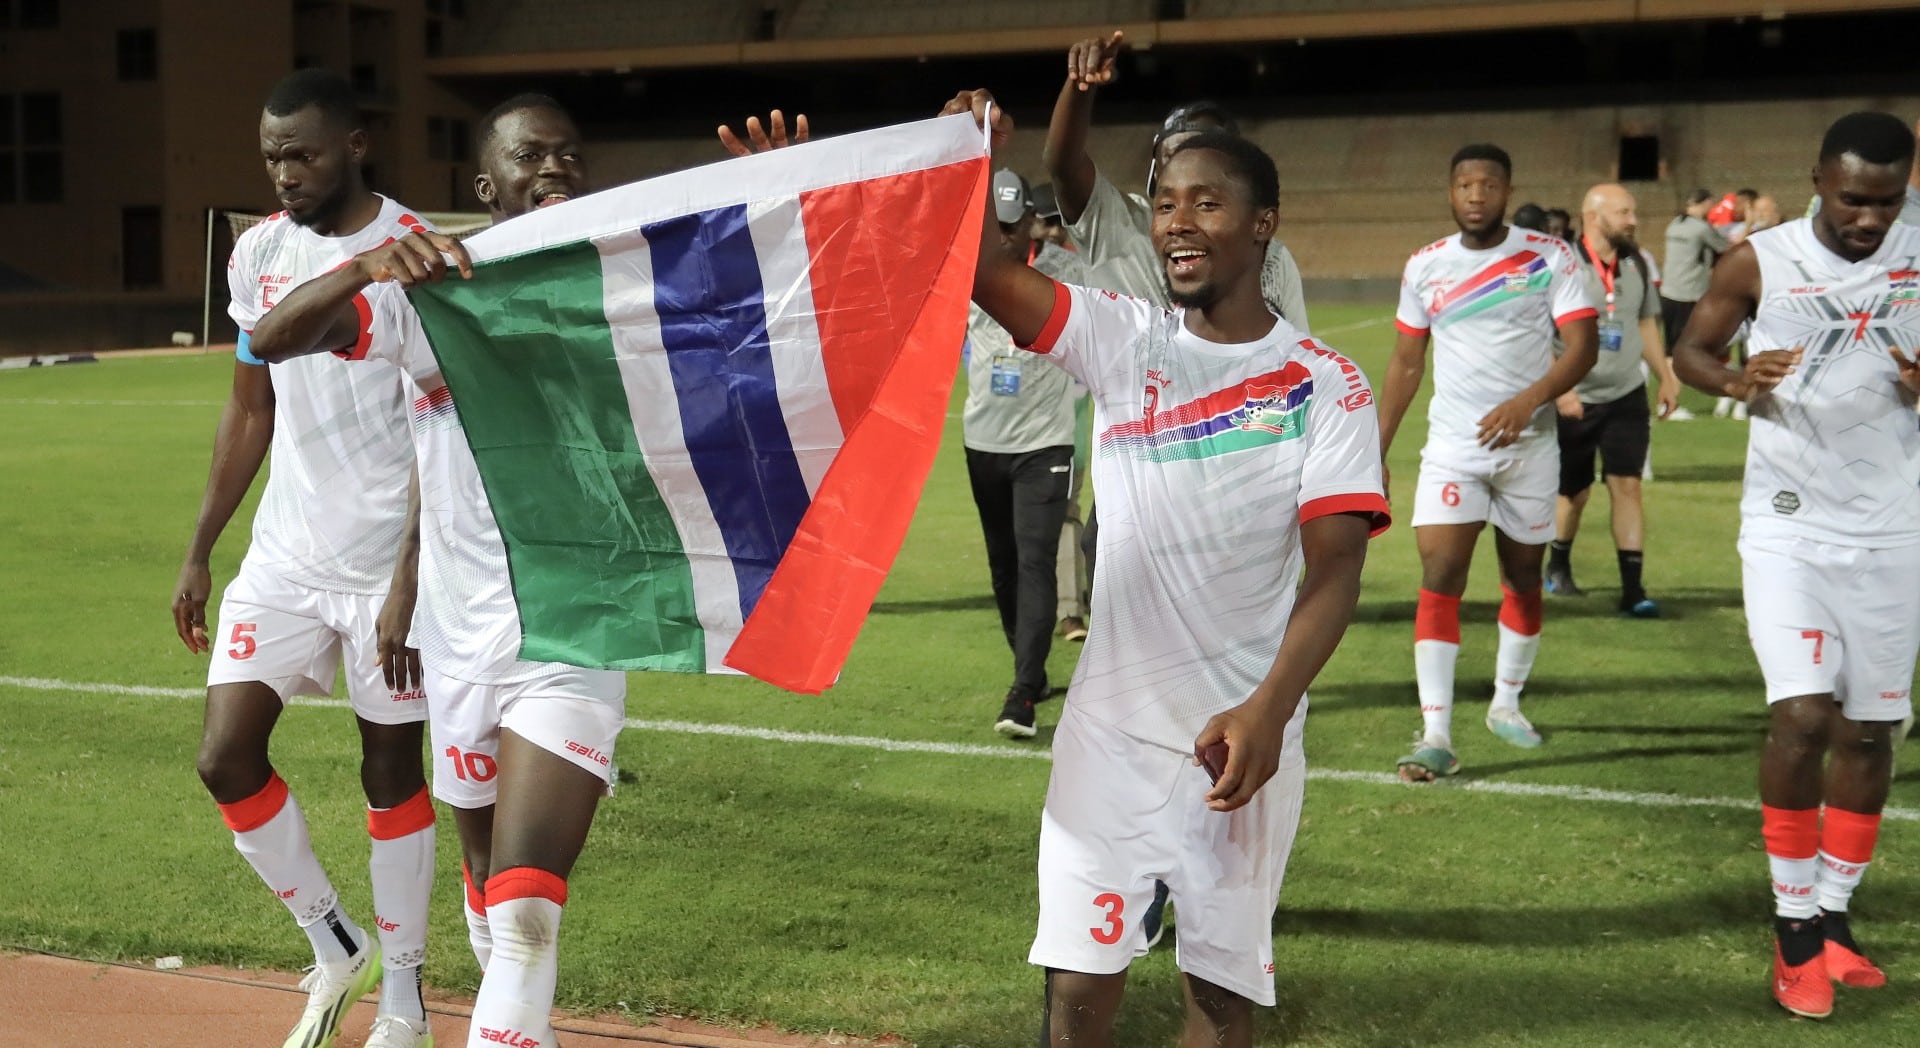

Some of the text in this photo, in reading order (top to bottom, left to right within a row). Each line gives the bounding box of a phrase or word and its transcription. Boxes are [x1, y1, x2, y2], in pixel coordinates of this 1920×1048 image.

[1848, 313, 1870, 340] 7
[1442, 482, 1460, 506] 6
[228, 623, 257, 660] 5
[1802, 630, 1823, 664] 7
[445, 745, 497, 782] 10
[1090, 893, 1125, 945] 3
